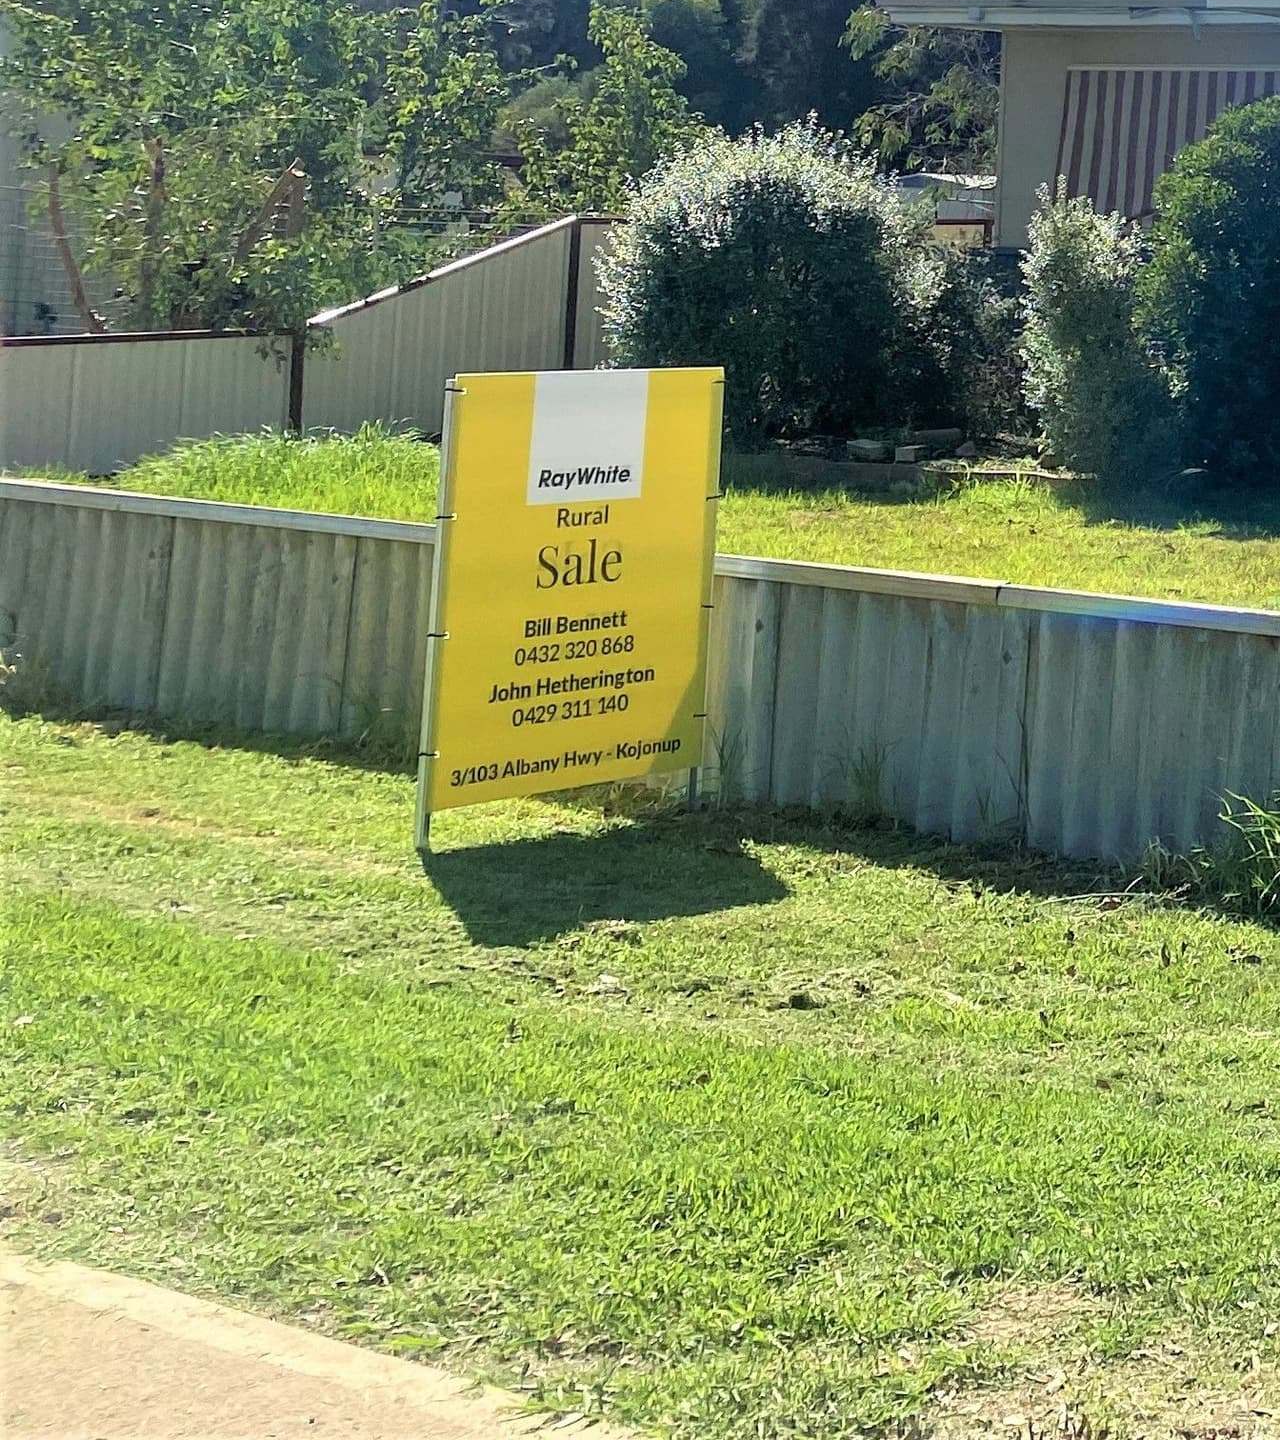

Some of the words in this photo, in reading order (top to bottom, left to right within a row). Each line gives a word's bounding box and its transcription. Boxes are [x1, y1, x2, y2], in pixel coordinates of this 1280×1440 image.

[557, 504, 609, 528] Rural
[536, 538, 622, 589] Sale
[524, 617, 551, 638] Bill
[556, 611, 628, 634] Bennett
[514, 644, 560, 666] 0432
[565, 639, 597, 660] 320
[601, 635, 634, 655] 868
[488, 682, 531, 703] John
[536, 668, 655, 696] Hetherington
[512, 704, 557, 727] 0429
[561, 699, 592, 720] 311
[598, 694, 629, 715] 140
[450, 763, 498, 787] 3/103
[501, 756, 560, 778] Albany
[564, 749, 603, 768] Hwy
[616, 738, 681, 759] Kojonup
